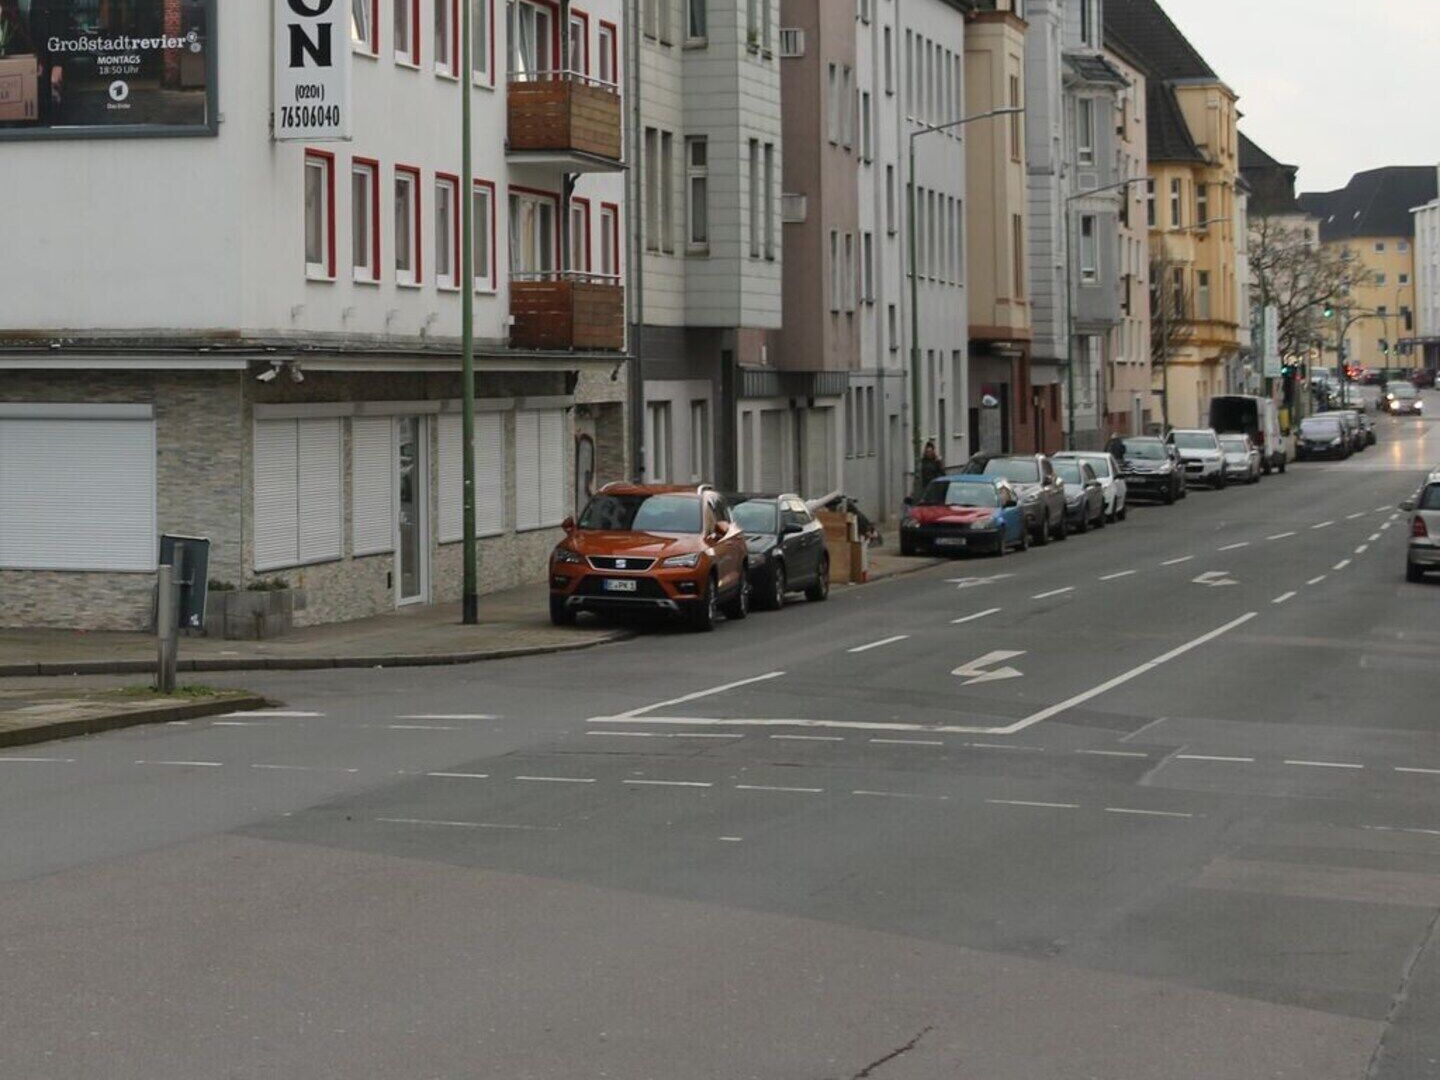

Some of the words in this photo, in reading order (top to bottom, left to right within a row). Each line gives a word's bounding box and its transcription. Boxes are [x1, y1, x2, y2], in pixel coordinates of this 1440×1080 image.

[47, 34, 187, 52] Großstadtrevier
[97, 55, 141, 65] MONTAGS
[123, 66, 139, 74] Uhr
[295, 84, 325, 102] (0201)
[281, 105, 340, 128] 76506040
